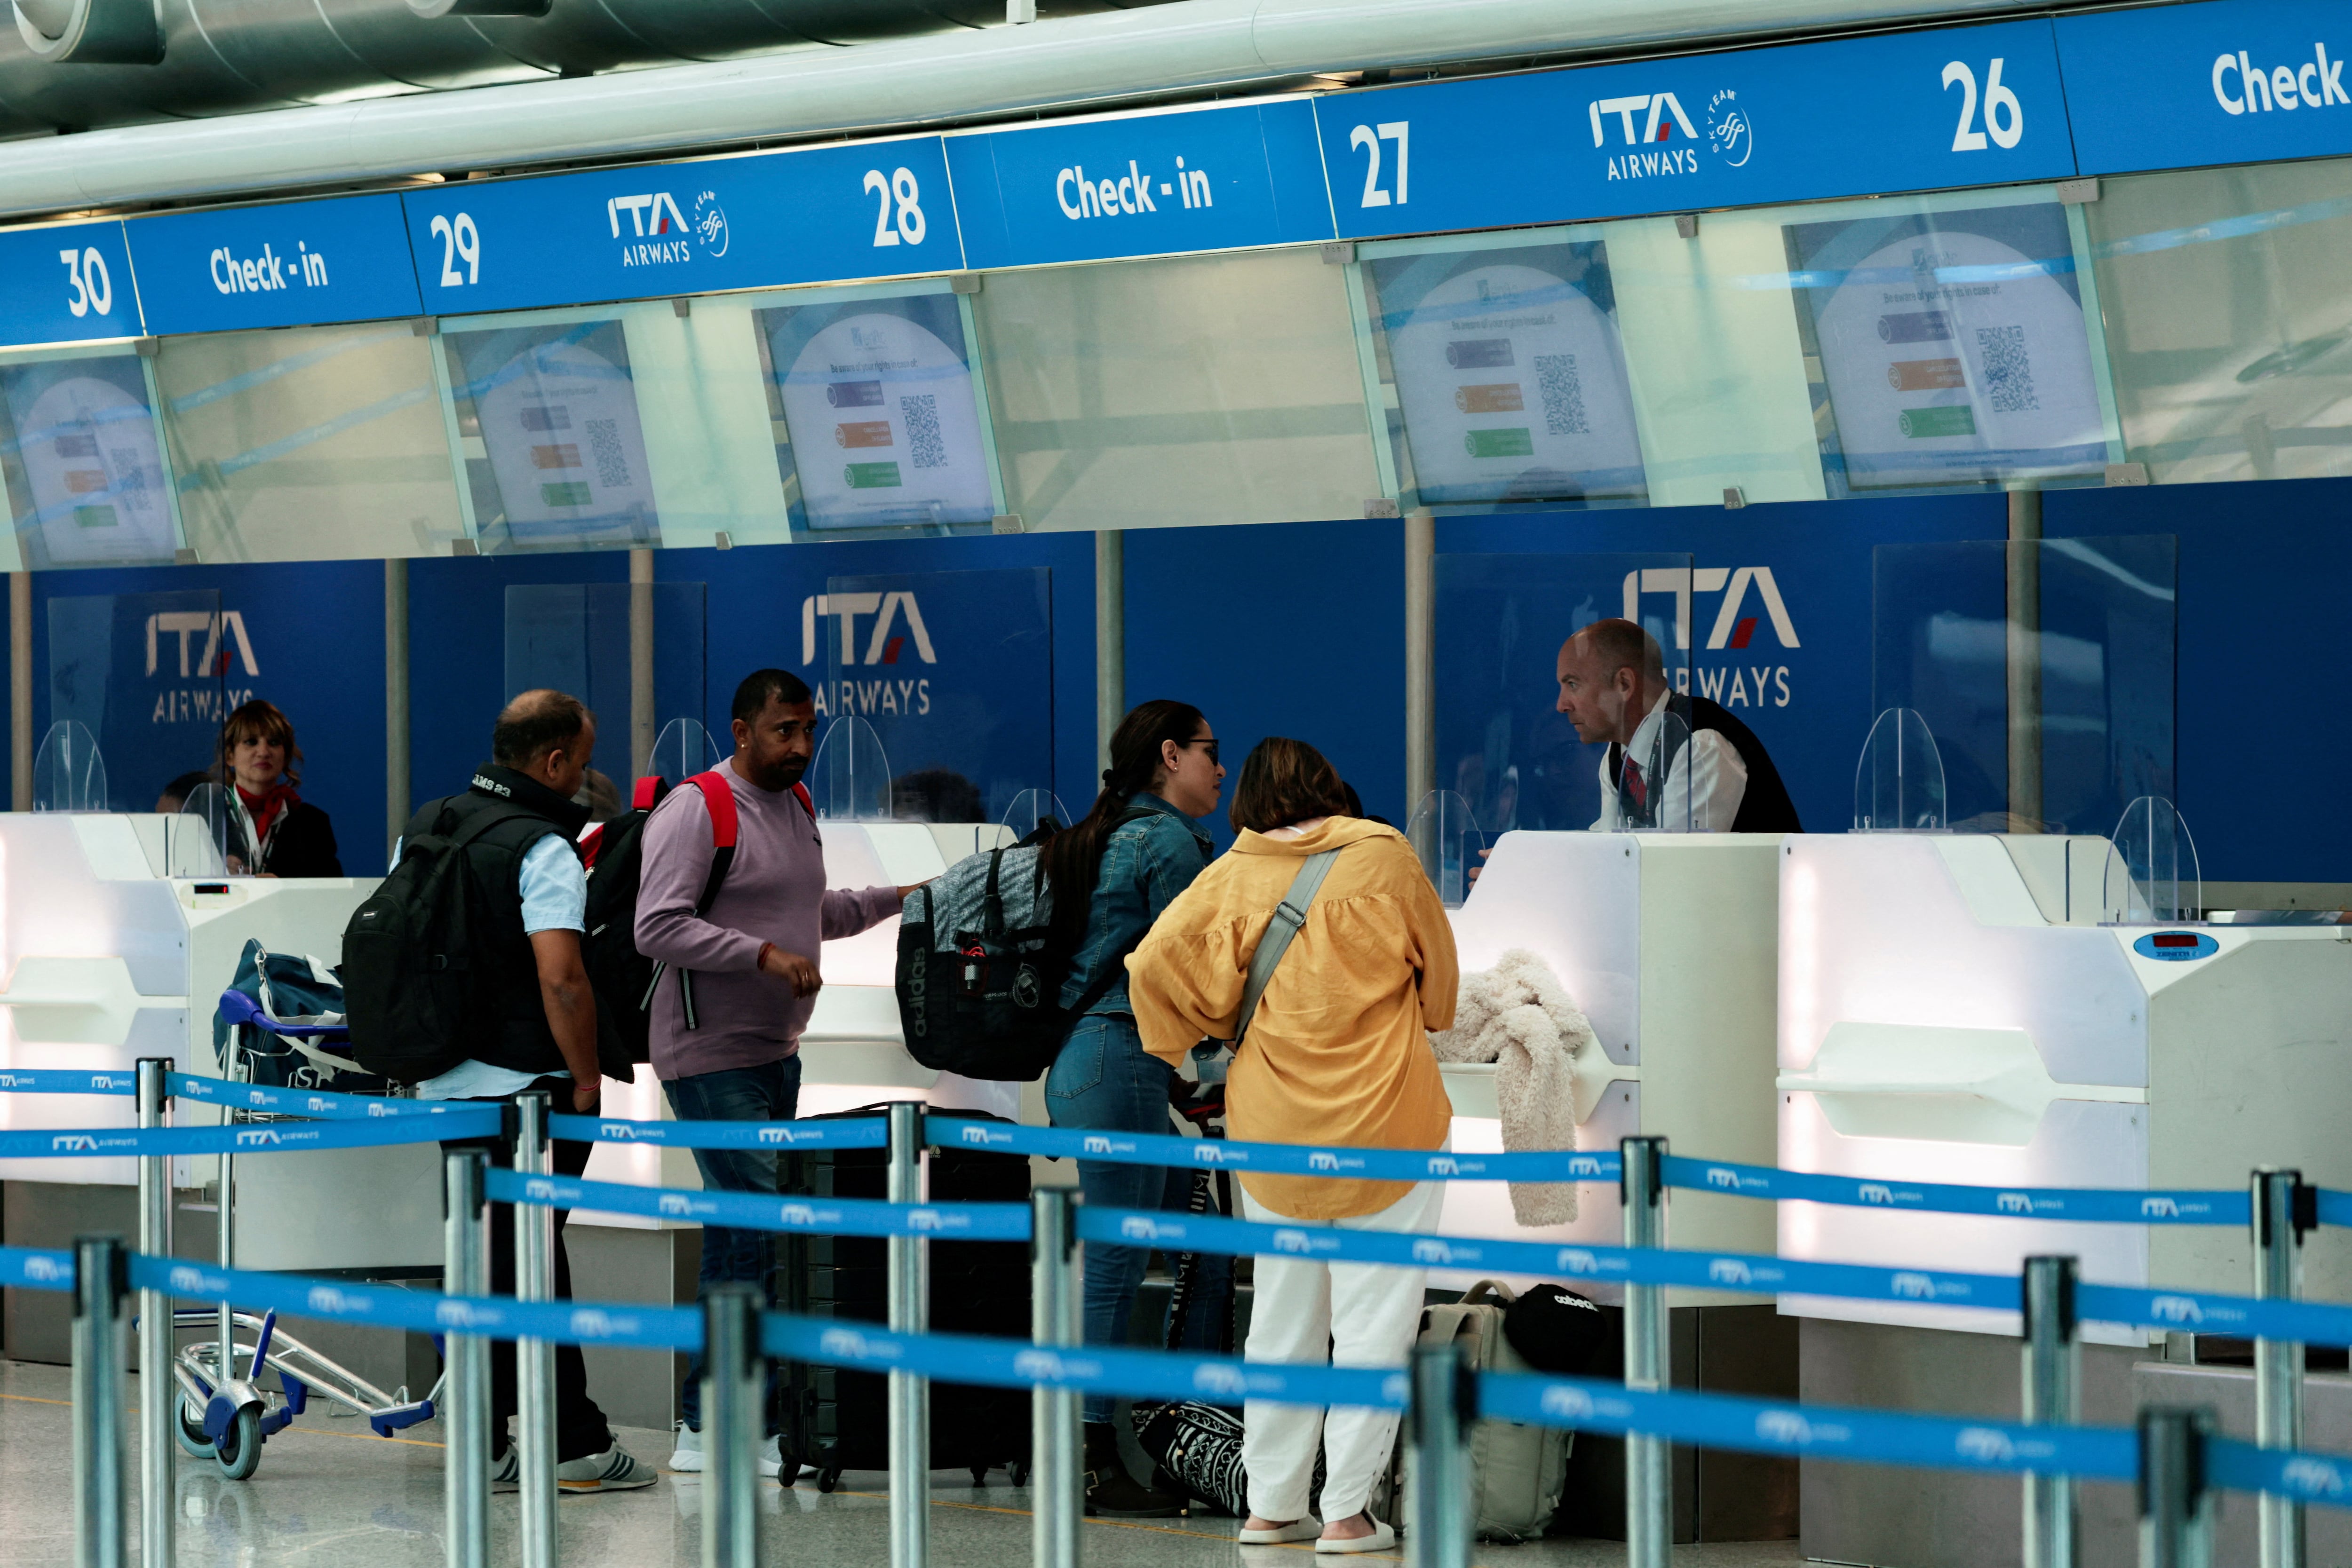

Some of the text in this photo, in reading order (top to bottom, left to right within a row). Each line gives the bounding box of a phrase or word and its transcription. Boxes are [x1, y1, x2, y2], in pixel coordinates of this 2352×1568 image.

[1941, 57, 2023, 151] 26
[2212, 42, 2351, 116] Check
[1589, 92, 1699, 148] ITA
[1350, 121, 1409, 208] 27
[1607, 149, 1698, 181] AIRWAYS
[607, 192, 690, 239] ITA
[863, 166, 926, 247] 28
[430, 212, 480, 287] 29
[623, 240, 690, 267] AIRWAYS
[59, 246, 112, 318] 30
[874, 361, 891, 372] rights
[802, 591, 937, 666] ITA
[1623, 566, 1801, 650] ITA
[146, 610, 260, 678] ITA
[814, 679, 930, 717] AIRWAYS
[1663, 665, 1791, 707] RWAYS
[907, 946, 927, 1037] adidas
[92, 1076, 113, 1089] ITA
[53, 1135, 138, 1150] ITA AIRWAYS
[237, 1130, 320, 1146] ITA AIRWAYS
[601, 1124, 636, 1139] ITA
[758, 1127, 795, 1143] ITA
